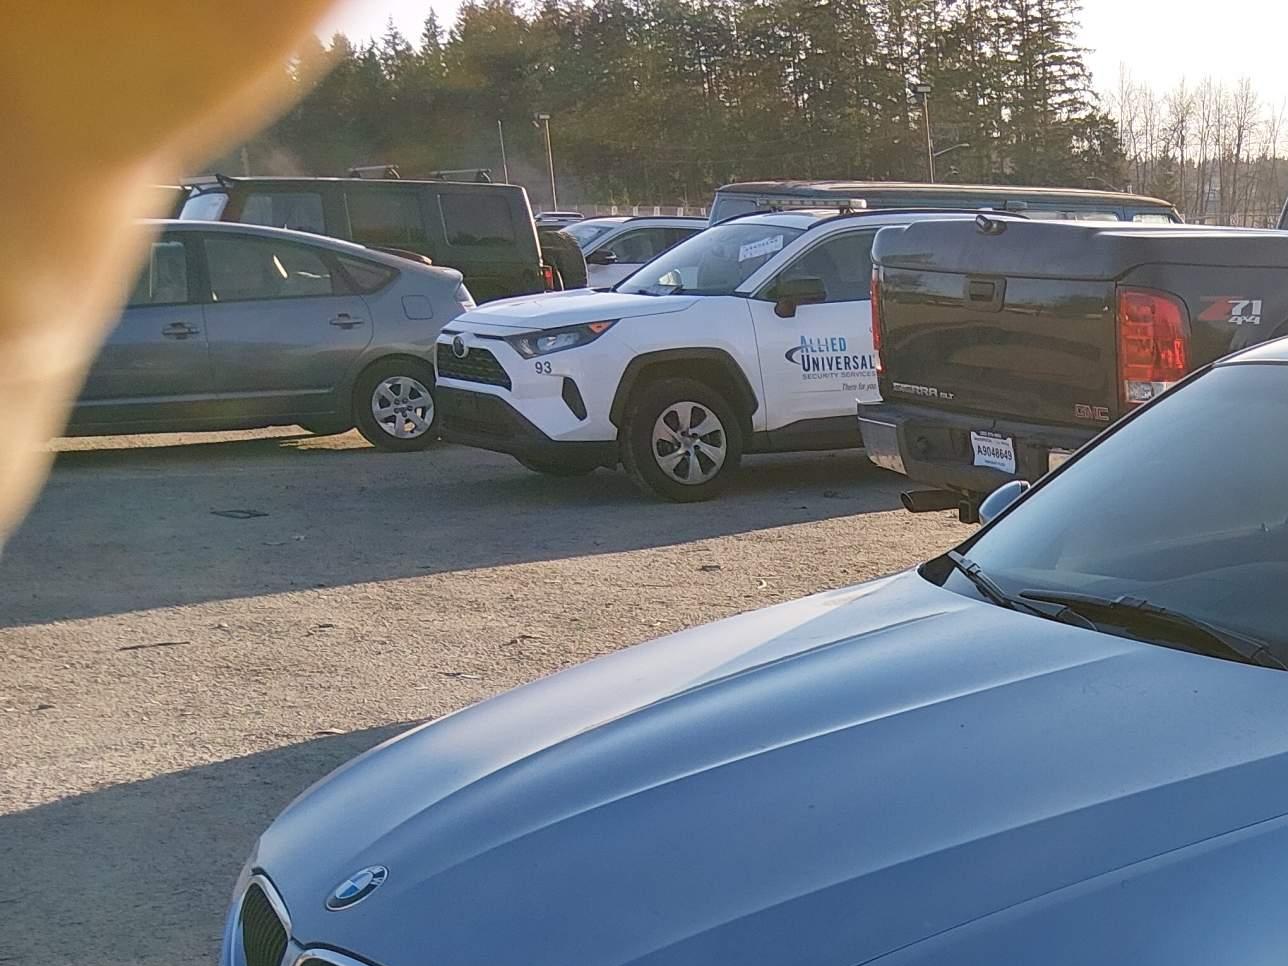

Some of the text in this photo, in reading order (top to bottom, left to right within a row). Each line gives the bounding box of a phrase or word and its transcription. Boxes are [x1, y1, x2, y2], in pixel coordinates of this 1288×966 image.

[800, 335, 847, 353] ALLIED
[535, 361, 552, 374] 93
[801, 354, 875, 372] UNIVERSAL
[802, 370, 876, 380] SECURITY SERVICES
